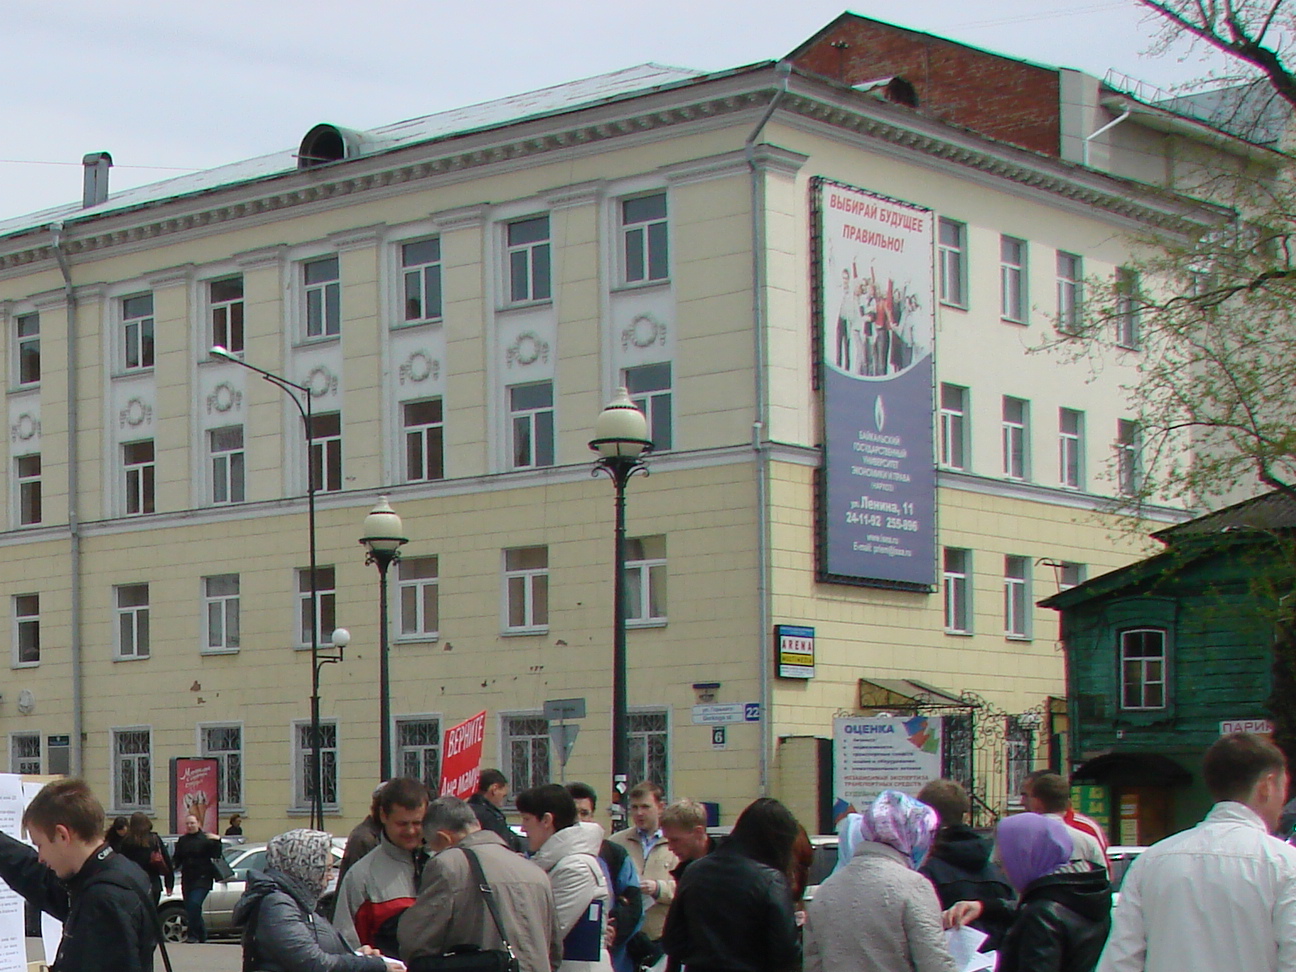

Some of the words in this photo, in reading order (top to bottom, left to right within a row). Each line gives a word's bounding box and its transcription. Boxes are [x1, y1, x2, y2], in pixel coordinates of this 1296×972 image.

[830, 194, 877, 220] ВЫБИРАЙ
[879, 208, 923, 233] БУДУЩЕЕ
[842, 224, 905, 253] ПРАВИЛЬНО!
[860, 496, 901, 516] Ленина,
[902, 502, 913, 515] 11
[846, 512, 882, 527] 24-11-92
[782, 639, 812, 651] ARENA
[746, 706, 759, 718] 22
[447, 714, 484, 758] ВЕРНИТЕ
[714, 731, 723, 743] 6
[844, 724, 895, 735] ОЦЕНКА
